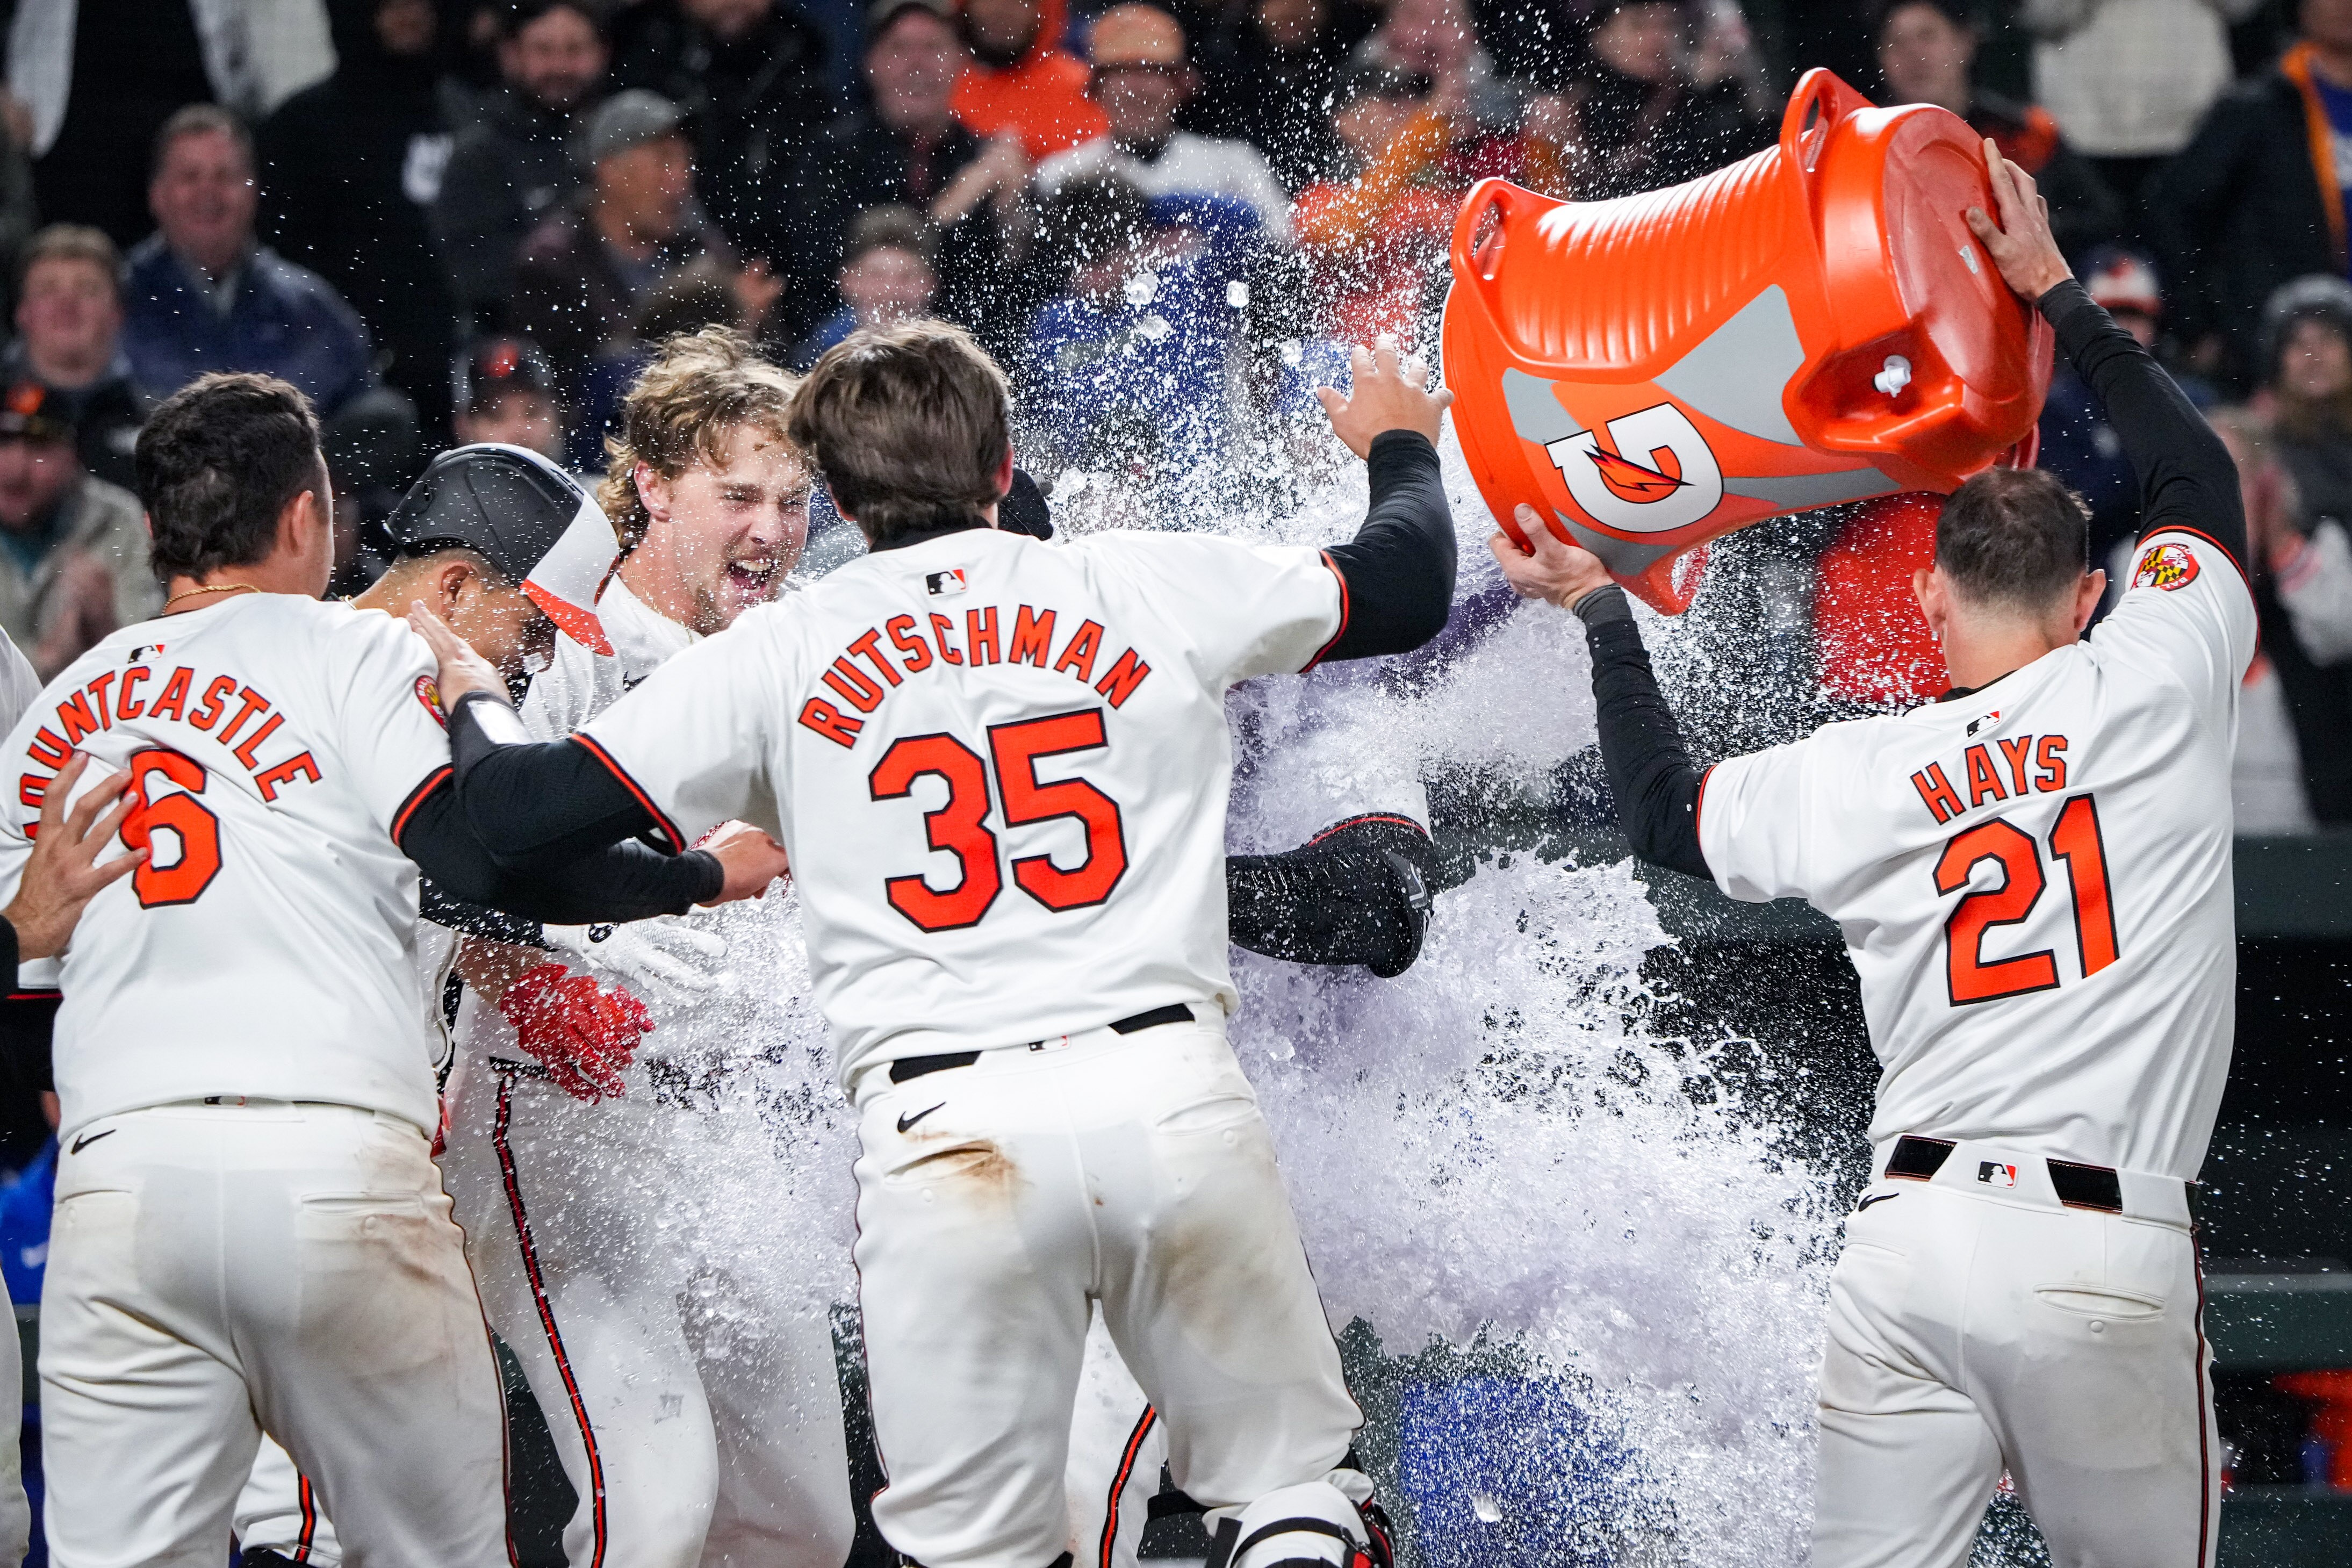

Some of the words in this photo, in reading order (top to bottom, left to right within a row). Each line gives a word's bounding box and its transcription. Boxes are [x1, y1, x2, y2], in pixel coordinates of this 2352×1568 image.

[19, 666, 322, 840] OUNTCASTLE
[798, 604, 1152, 750] RUTSCHMAN
[120, 749, 223, 909] 6
[868, 707, 1129, 933] 35
[1910, 735, 2068, 825] HAYS
[1932, 793, 2120, 1007] 21
